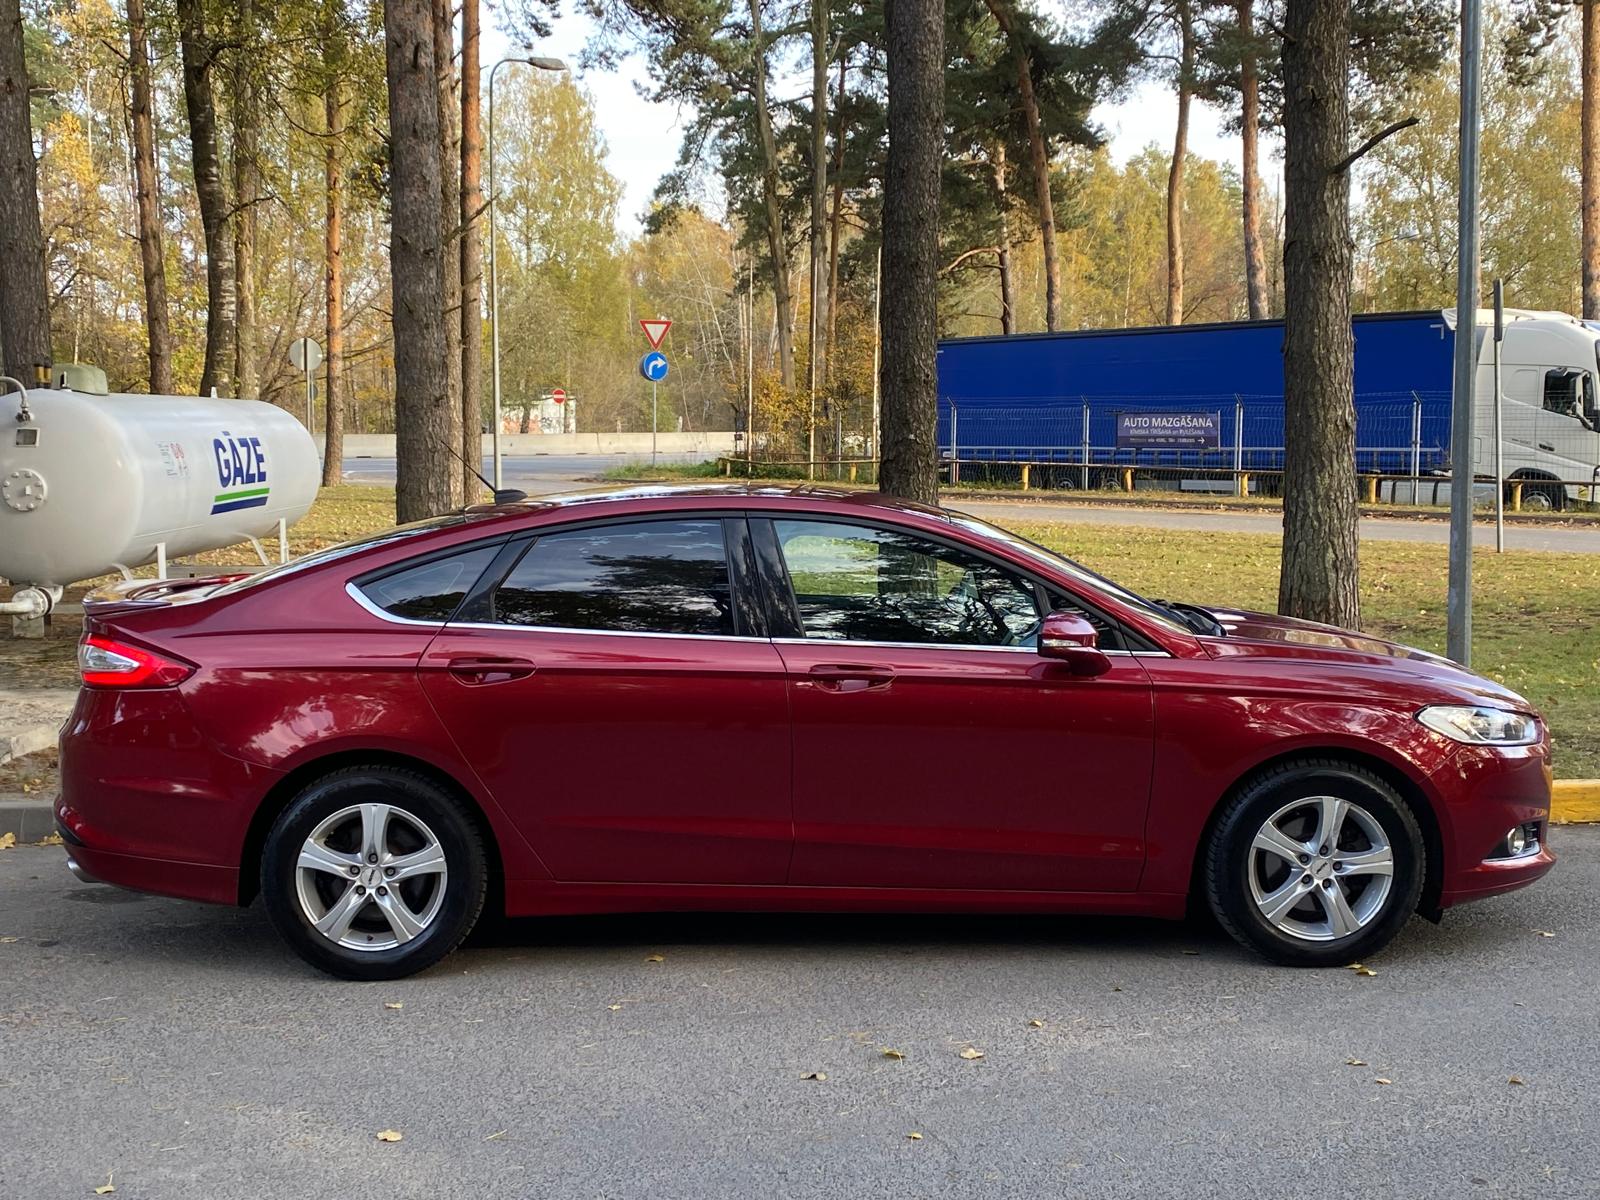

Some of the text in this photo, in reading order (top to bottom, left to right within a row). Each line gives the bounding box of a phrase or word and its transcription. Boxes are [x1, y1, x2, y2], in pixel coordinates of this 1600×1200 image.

[1123, 416, 1213, 428] AUTO MAZGĀŠANA
[213, 431, 267, 488] GĀZE
